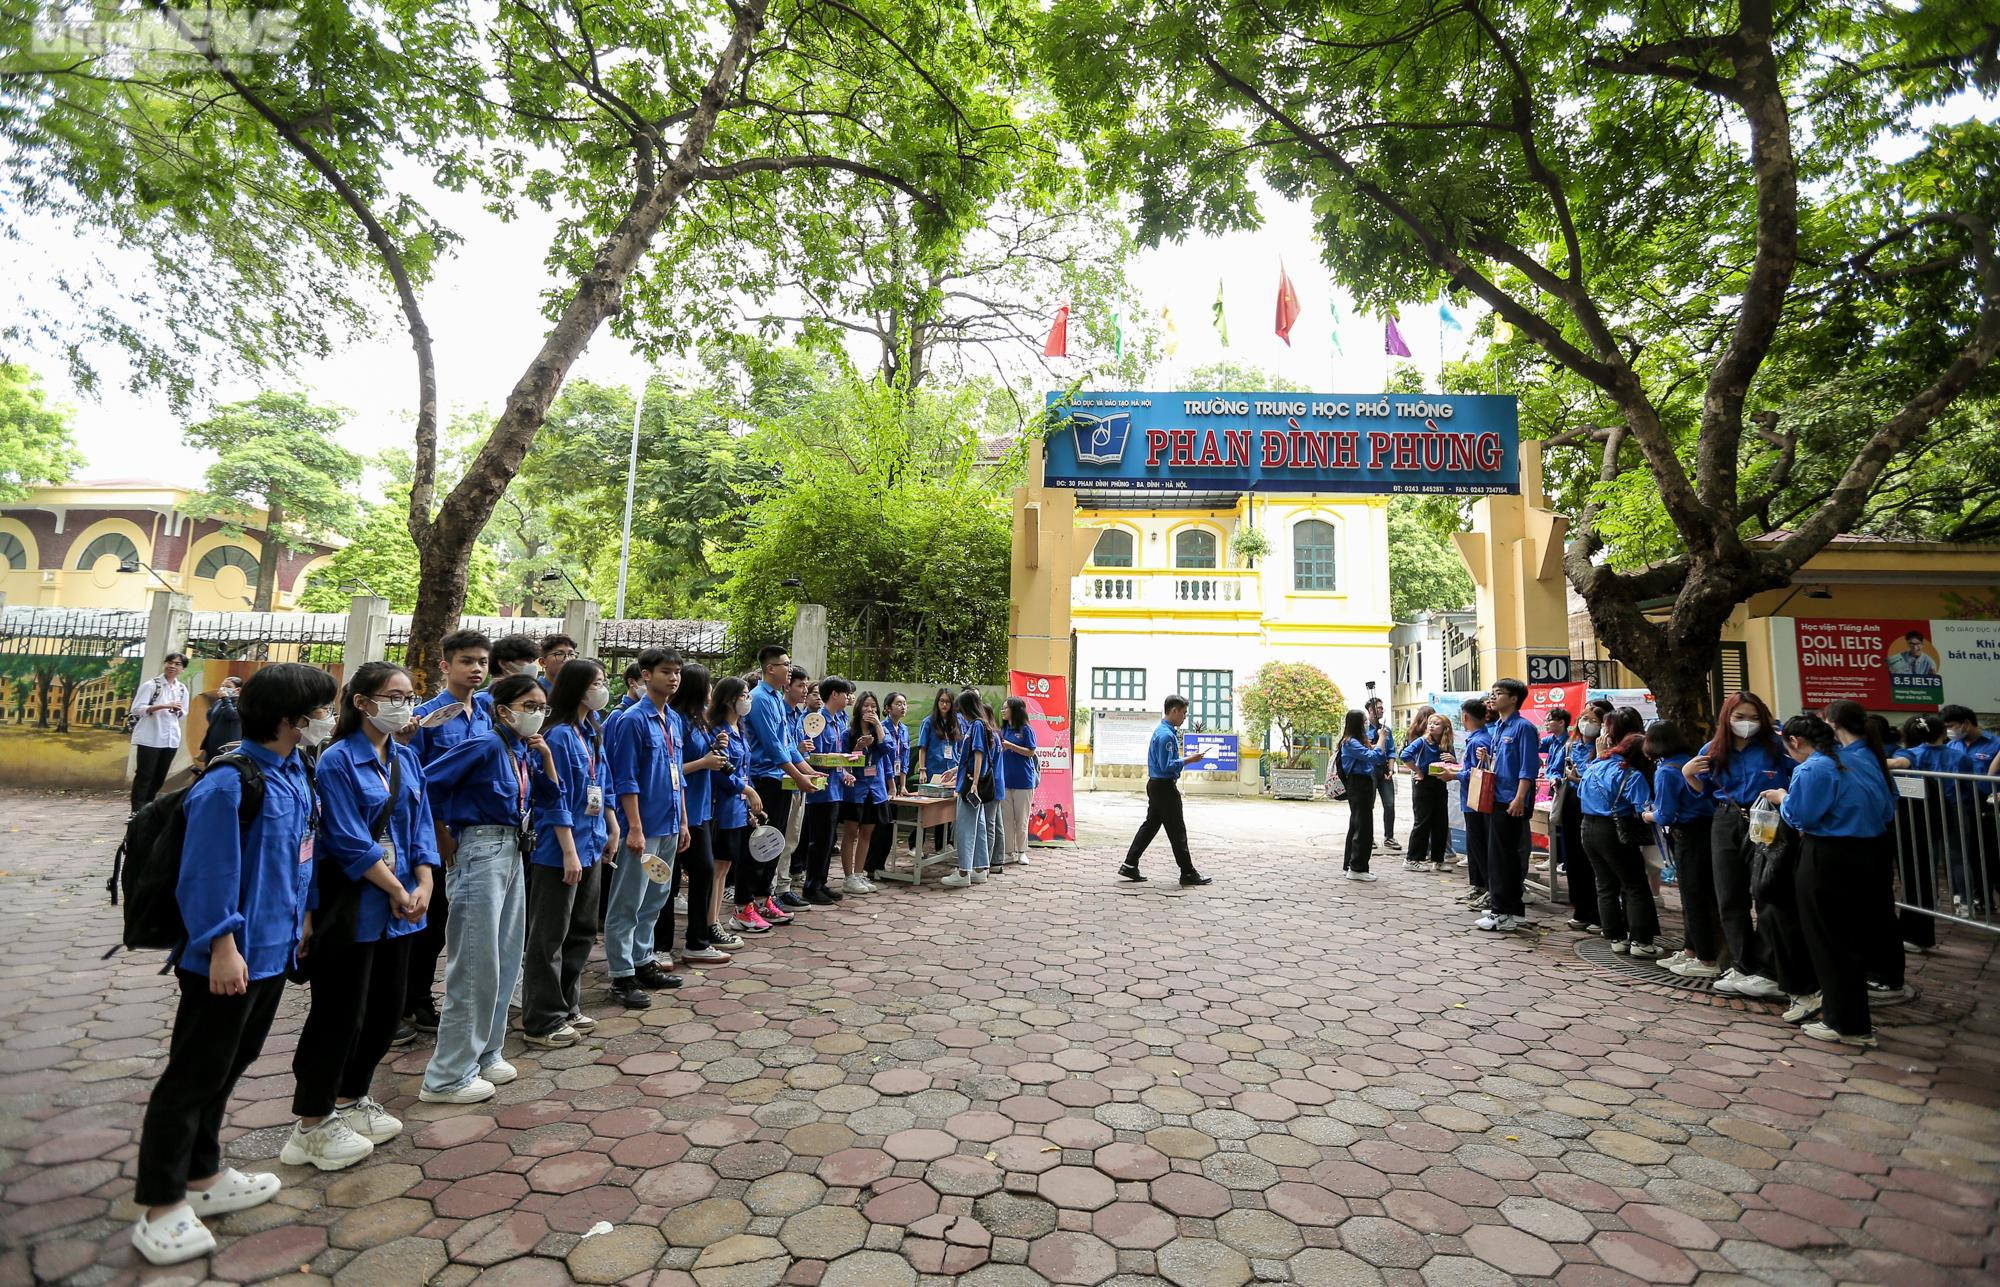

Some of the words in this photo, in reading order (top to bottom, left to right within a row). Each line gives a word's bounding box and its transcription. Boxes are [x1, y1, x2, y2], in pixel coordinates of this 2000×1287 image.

[1141, 399, 1152, 408] NỘI
[1184, 398, 1249, 416] TRƯỜNG
[1255, 401, 1306, 416] TRUNG
[1312, 402, 1350, 420] HỌC
[1355, 396, 1390, 417] PHỔ
[1396, 400, 1454, 418] THÔNG
[1145, 429, 1251, 468] PHAN
[1261, 417, 1360, 469] ĐÌNH
[1367, 418, 1504, 472] PHÙNG
[1095, 479, 1109, 487] ĐÌNH
[1110, 480, 1129, 488] PHÙNG
[1165, 480, 1173, 488] HÀ
[1801, 623, 1819, 632] Học
[1820, 623, 1837, 632] viện
[1838, 623, 1862, 632] Tiếng
[1863, 624, 1880, 632] Anh
[1801, 636, 1837, 650] DOL
[1841, 636, 1883, 650] IELTS
[1976, 639, 1995, 649] Khi
[1802, 650, 1844, 667] ĐÌNH
[1849, 653, 1882, 671] LỰC
[1530, 657, 1567, 680] 30
[1894, 676, 1910, 685] 8.5
[1912, 677, 1941, 686] IELTS
